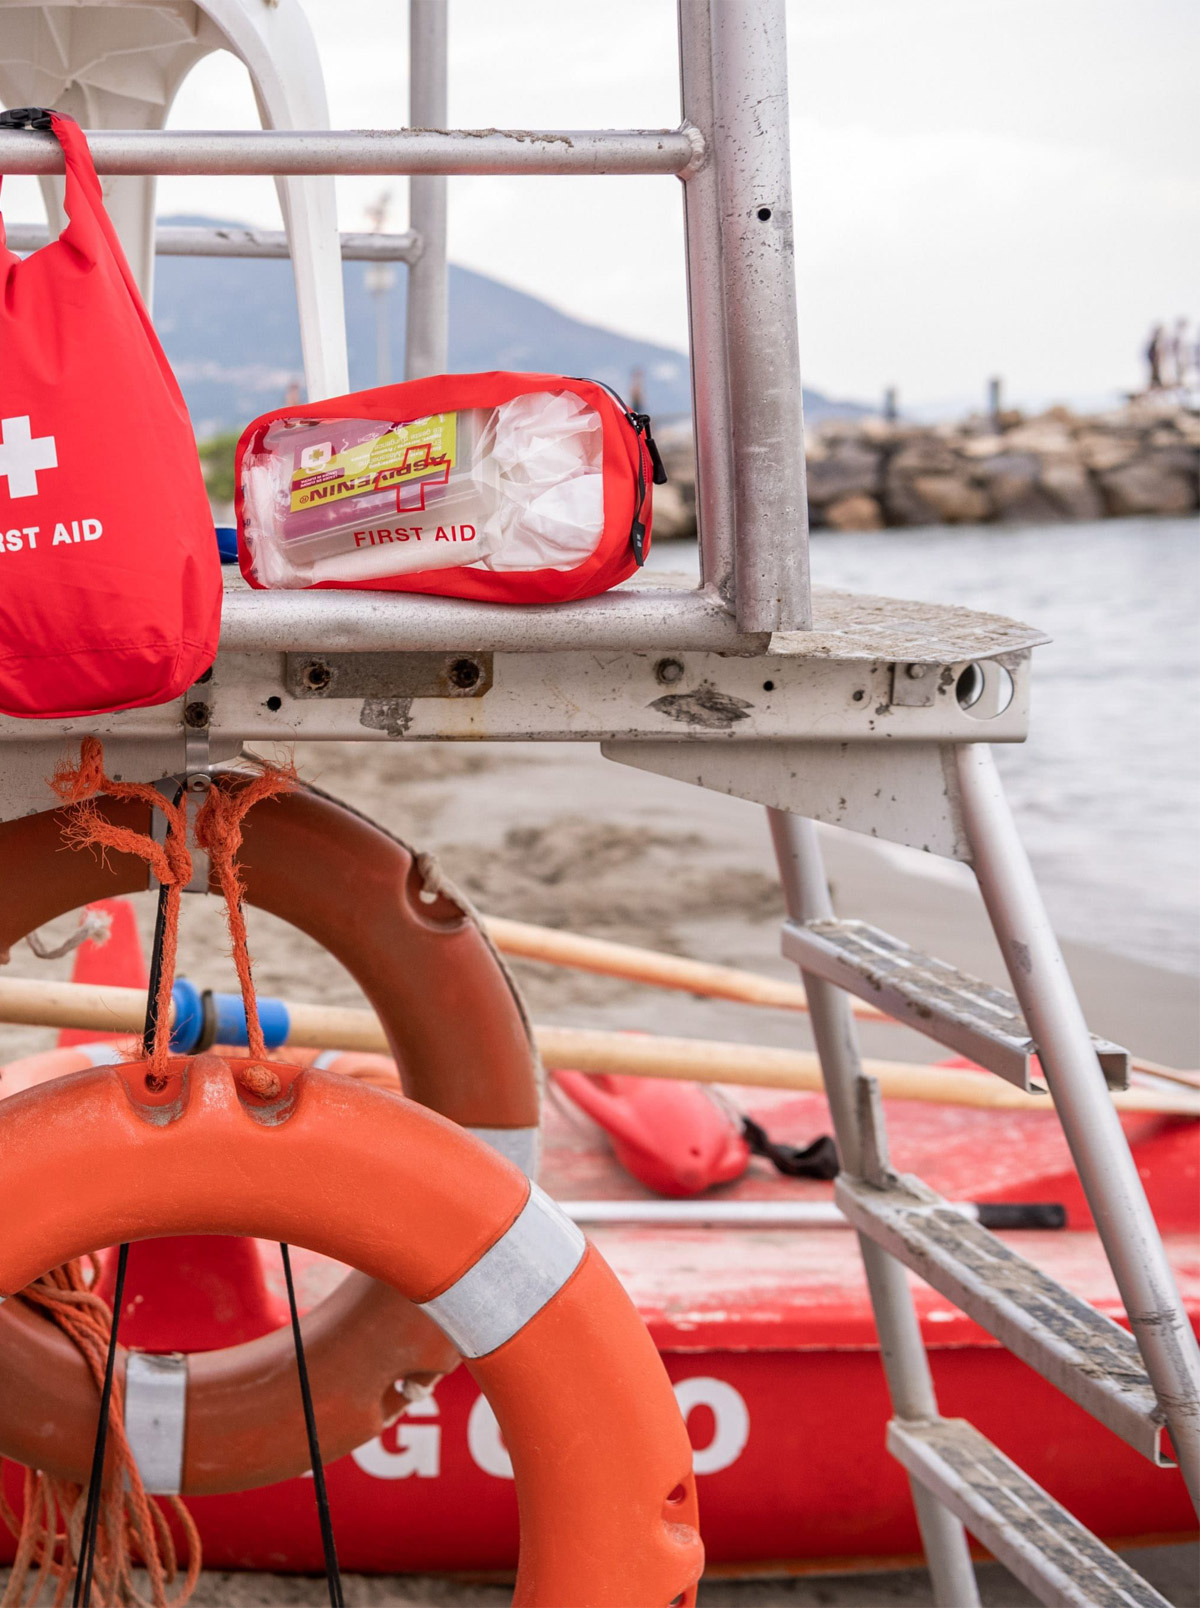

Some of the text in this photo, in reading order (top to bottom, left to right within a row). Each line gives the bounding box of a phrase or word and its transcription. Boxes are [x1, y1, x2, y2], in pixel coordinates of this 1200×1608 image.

[52, 518, 103, 546] AID
[354, 524, 476, 547] FIRST AID
